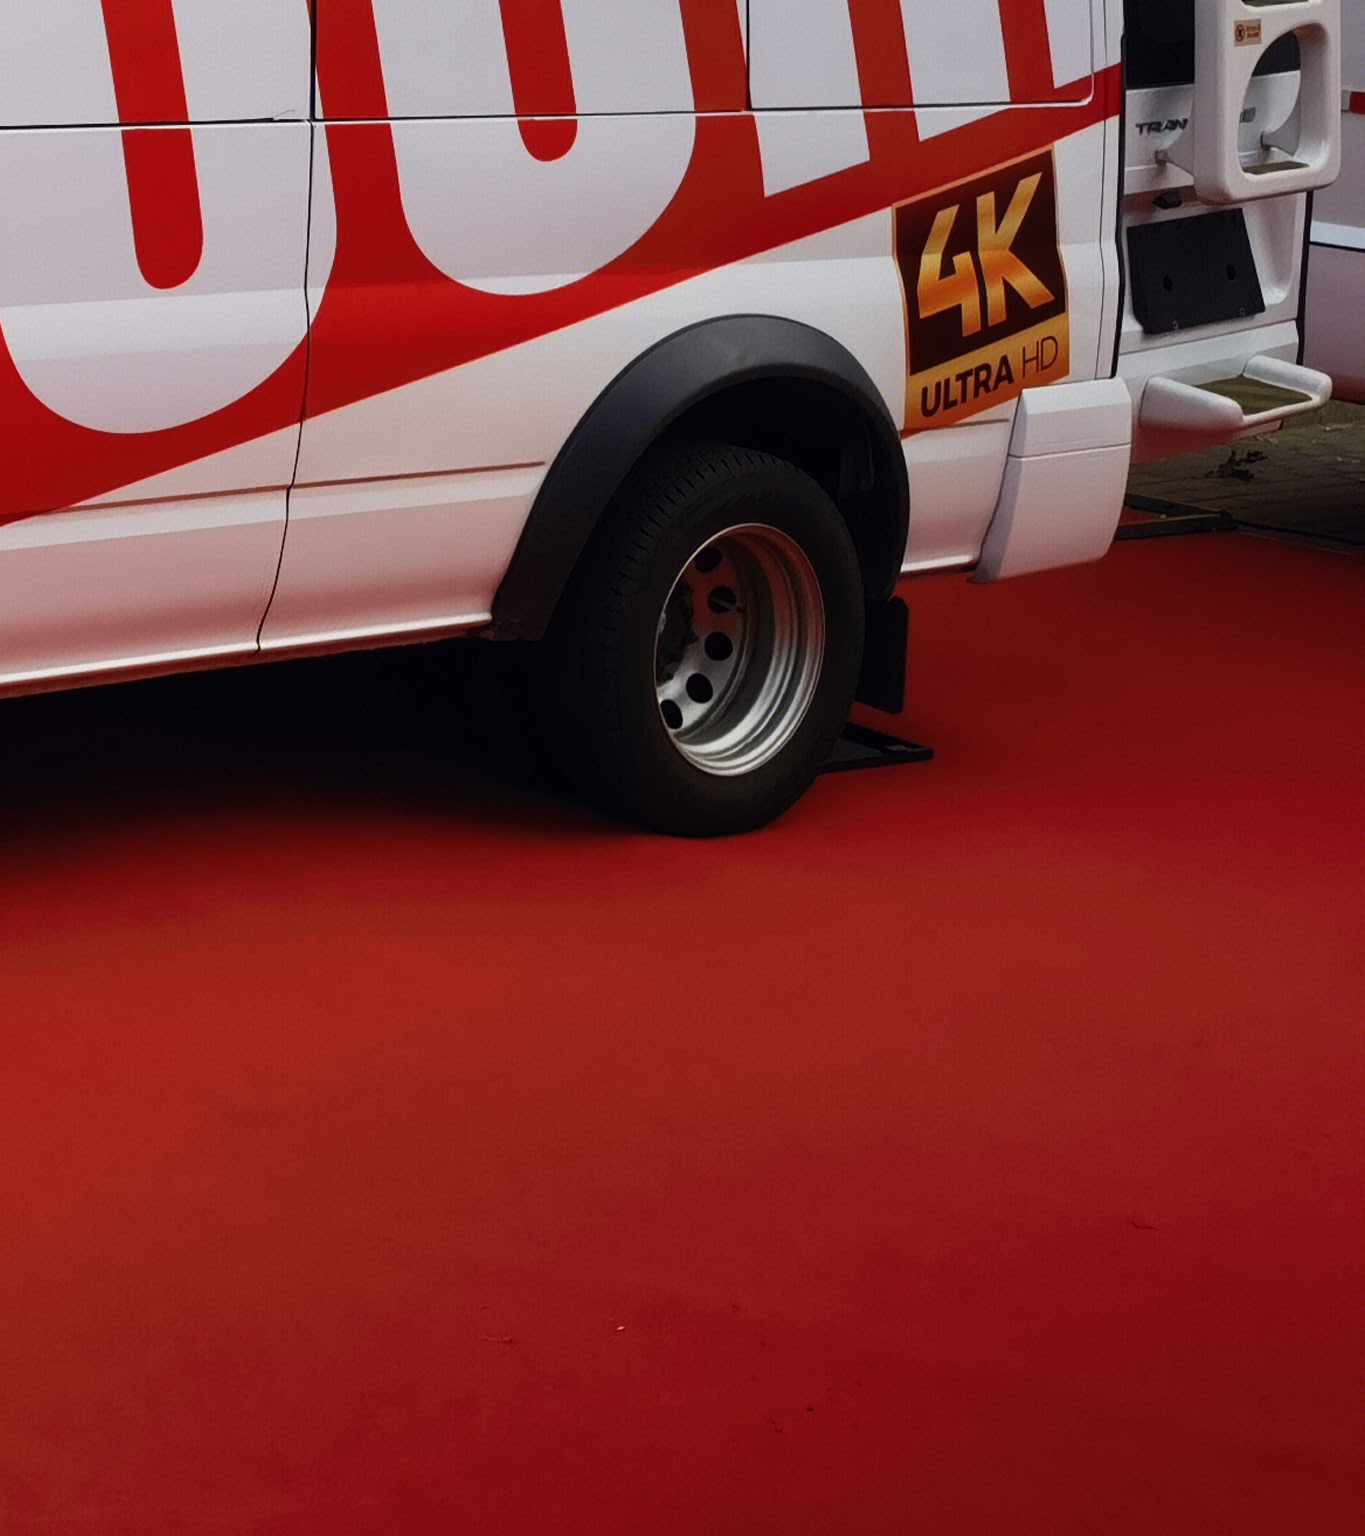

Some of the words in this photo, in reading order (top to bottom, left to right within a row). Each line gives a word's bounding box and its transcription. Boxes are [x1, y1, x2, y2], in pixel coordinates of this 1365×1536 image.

[918, 172, 1056, 338] 4K
[921, 356, 1014, 417] ULTRA
[1021, 333, 1060, 381] HD
